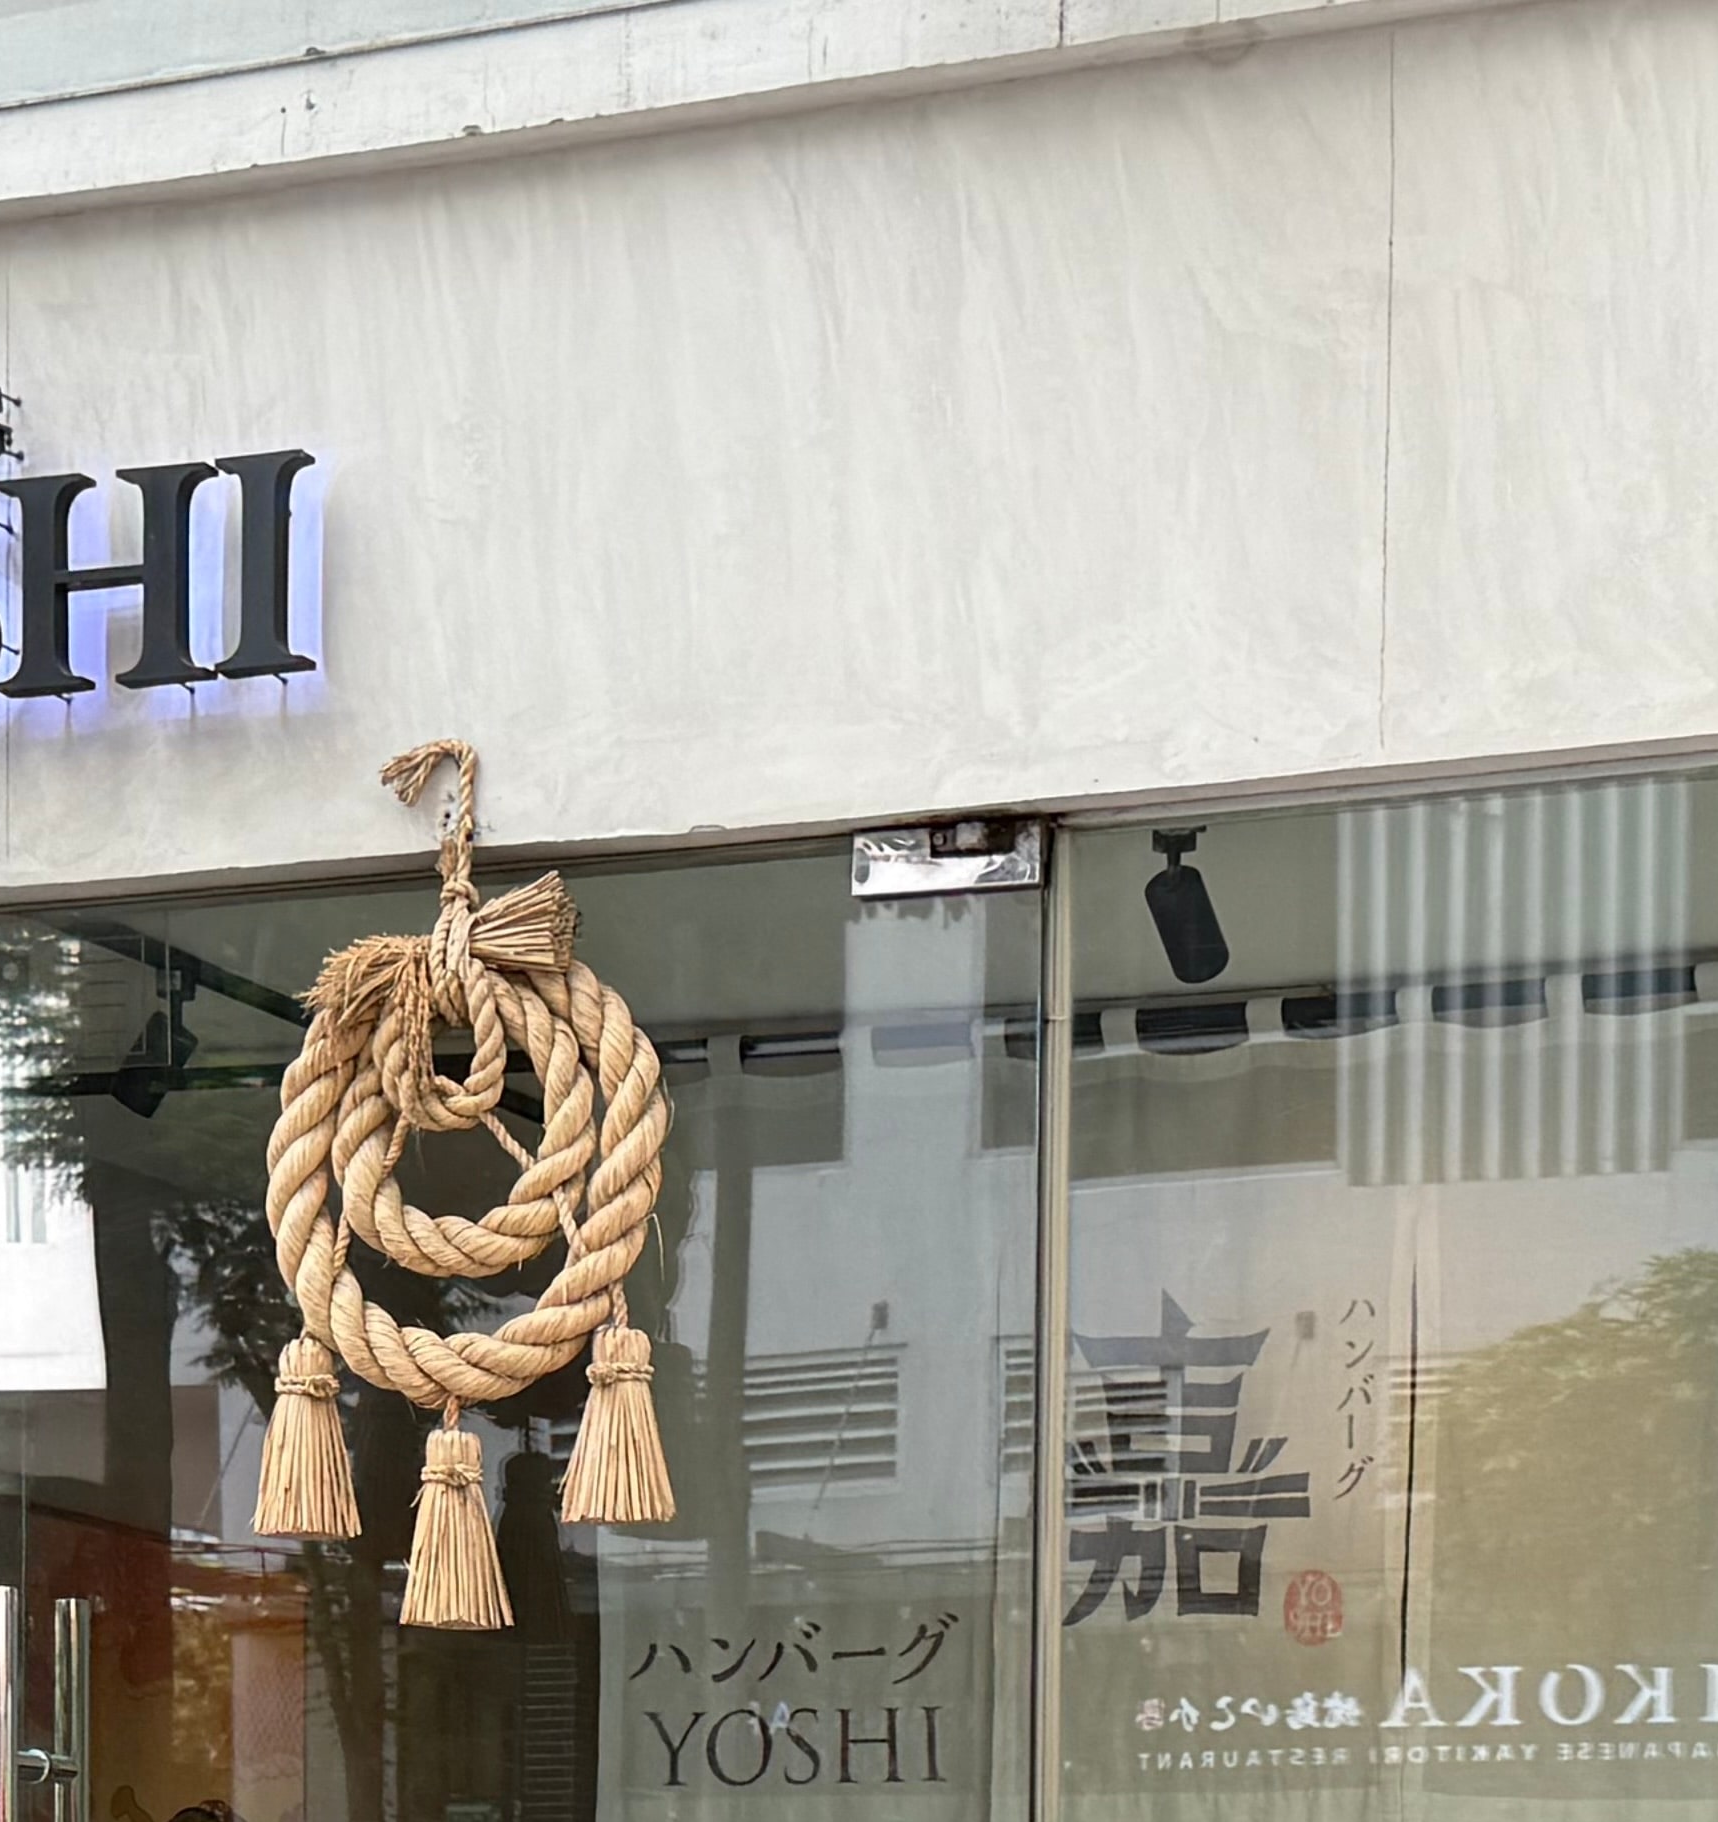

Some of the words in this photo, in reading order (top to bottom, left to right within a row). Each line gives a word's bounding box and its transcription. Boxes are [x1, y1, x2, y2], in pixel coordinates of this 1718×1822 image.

[1335, 1298, 1376, 1501] ハンバーグ
[629, 1612, 959, 1683] ハンバーグ
[643, 1703, 949, 1787] YOSHI
